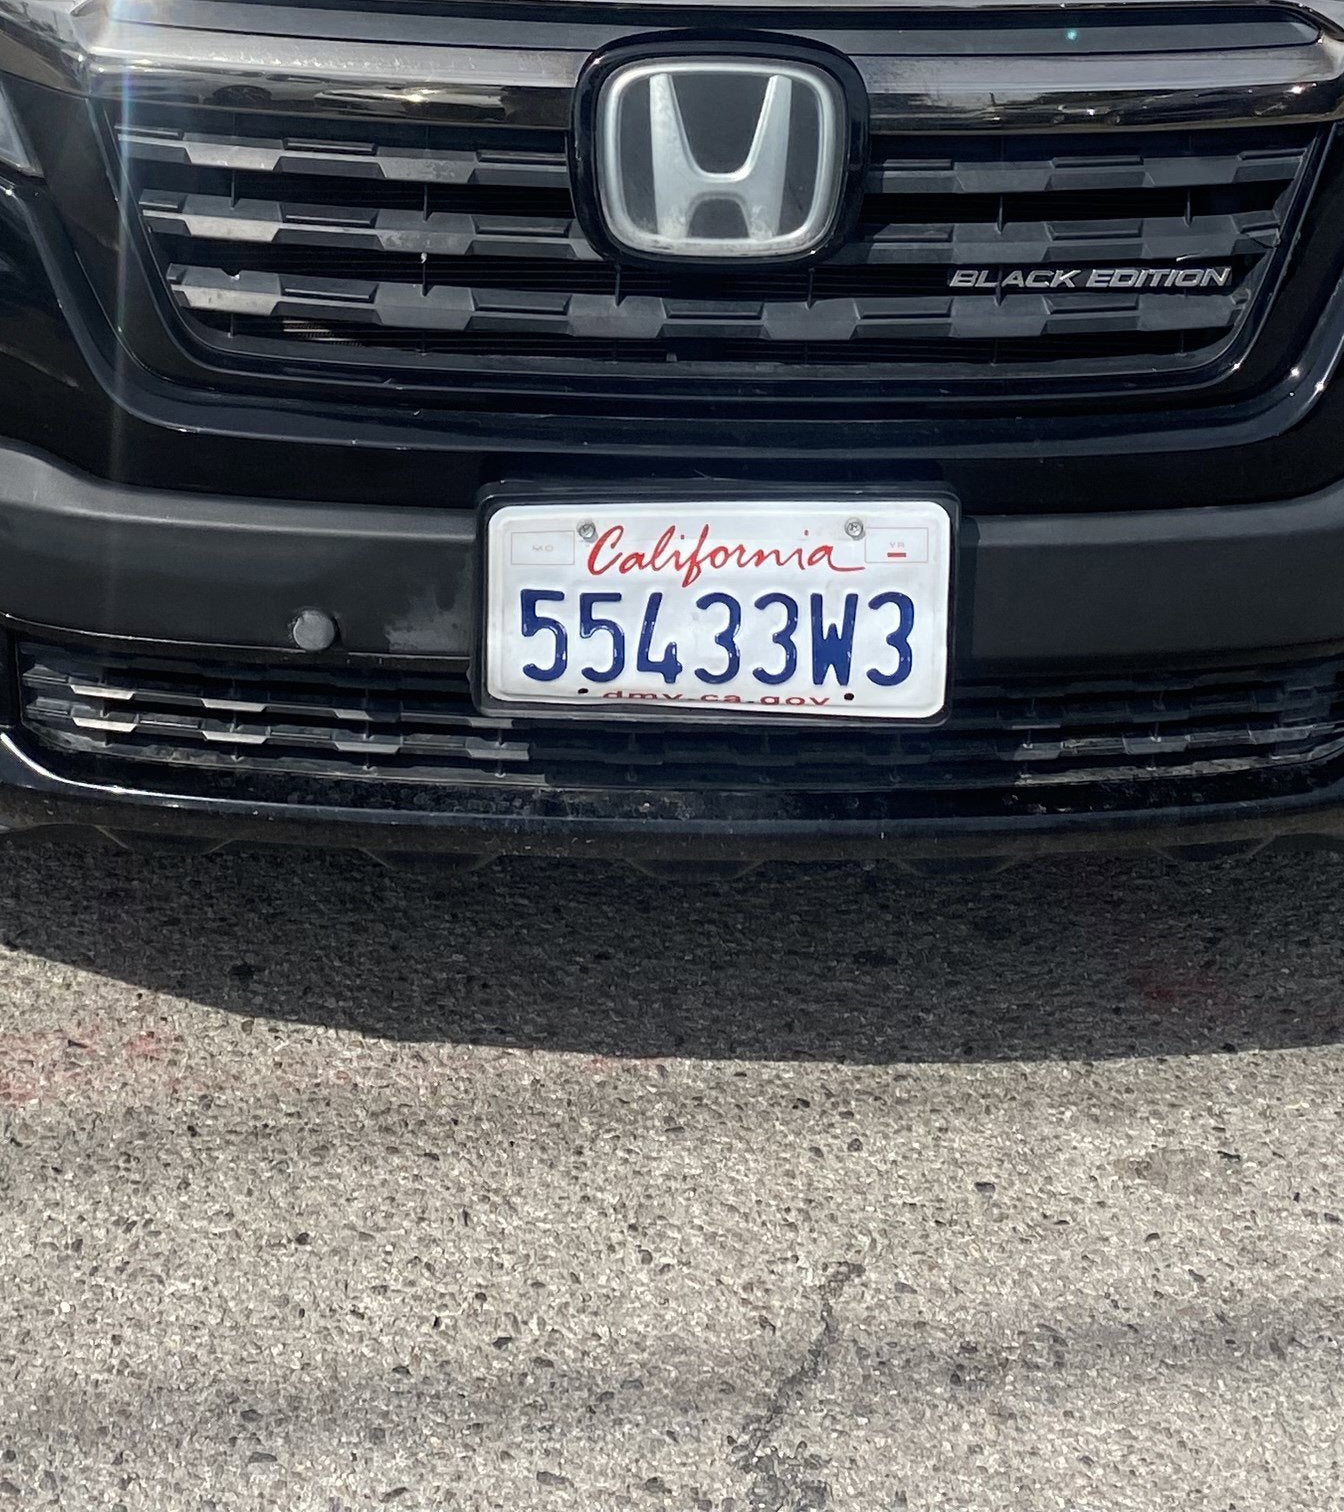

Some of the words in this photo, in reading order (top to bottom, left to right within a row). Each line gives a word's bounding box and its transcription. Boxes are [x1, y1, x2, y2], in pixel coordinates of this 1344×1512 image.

[949, 268, 1081, 288] BLACK
[1085, 265, 1232, 288] EDITION
[586, 522, 865, 588] California
[520, 588, 915, 687] 55433W3
